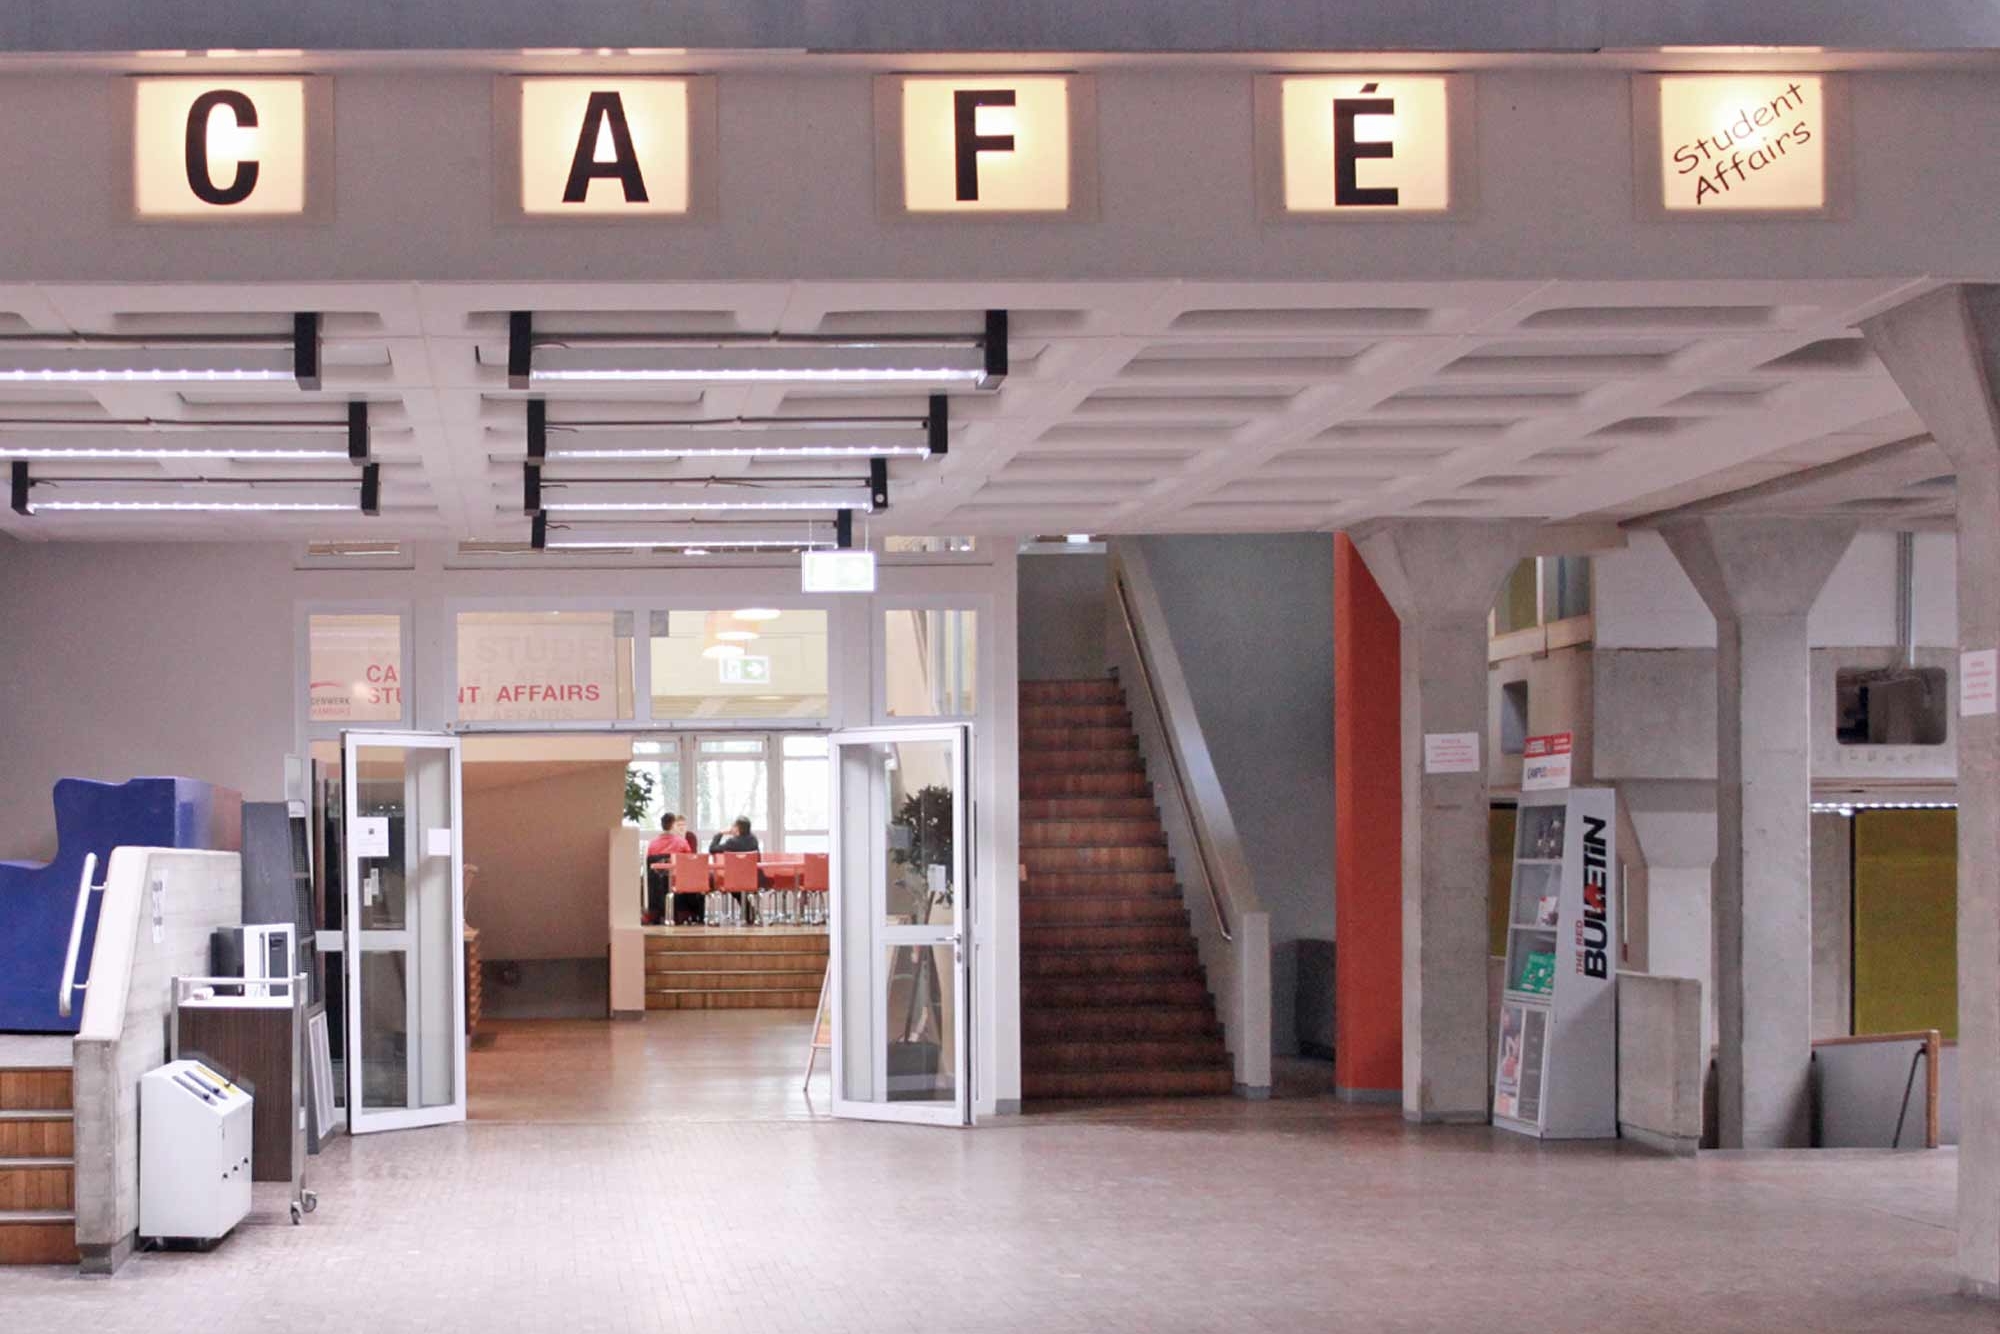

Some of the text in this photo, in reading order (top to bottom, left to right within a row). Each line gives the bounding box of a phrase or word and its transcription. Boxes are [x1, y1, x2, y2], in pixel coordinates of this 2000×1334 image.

[1673, 83, 1804, 174] Student
[1696, 121, 1811, 205] Affairs
[496, 684, 601, 702] AFFAIRS
[1575, 919, 1584, 975] THE RED
